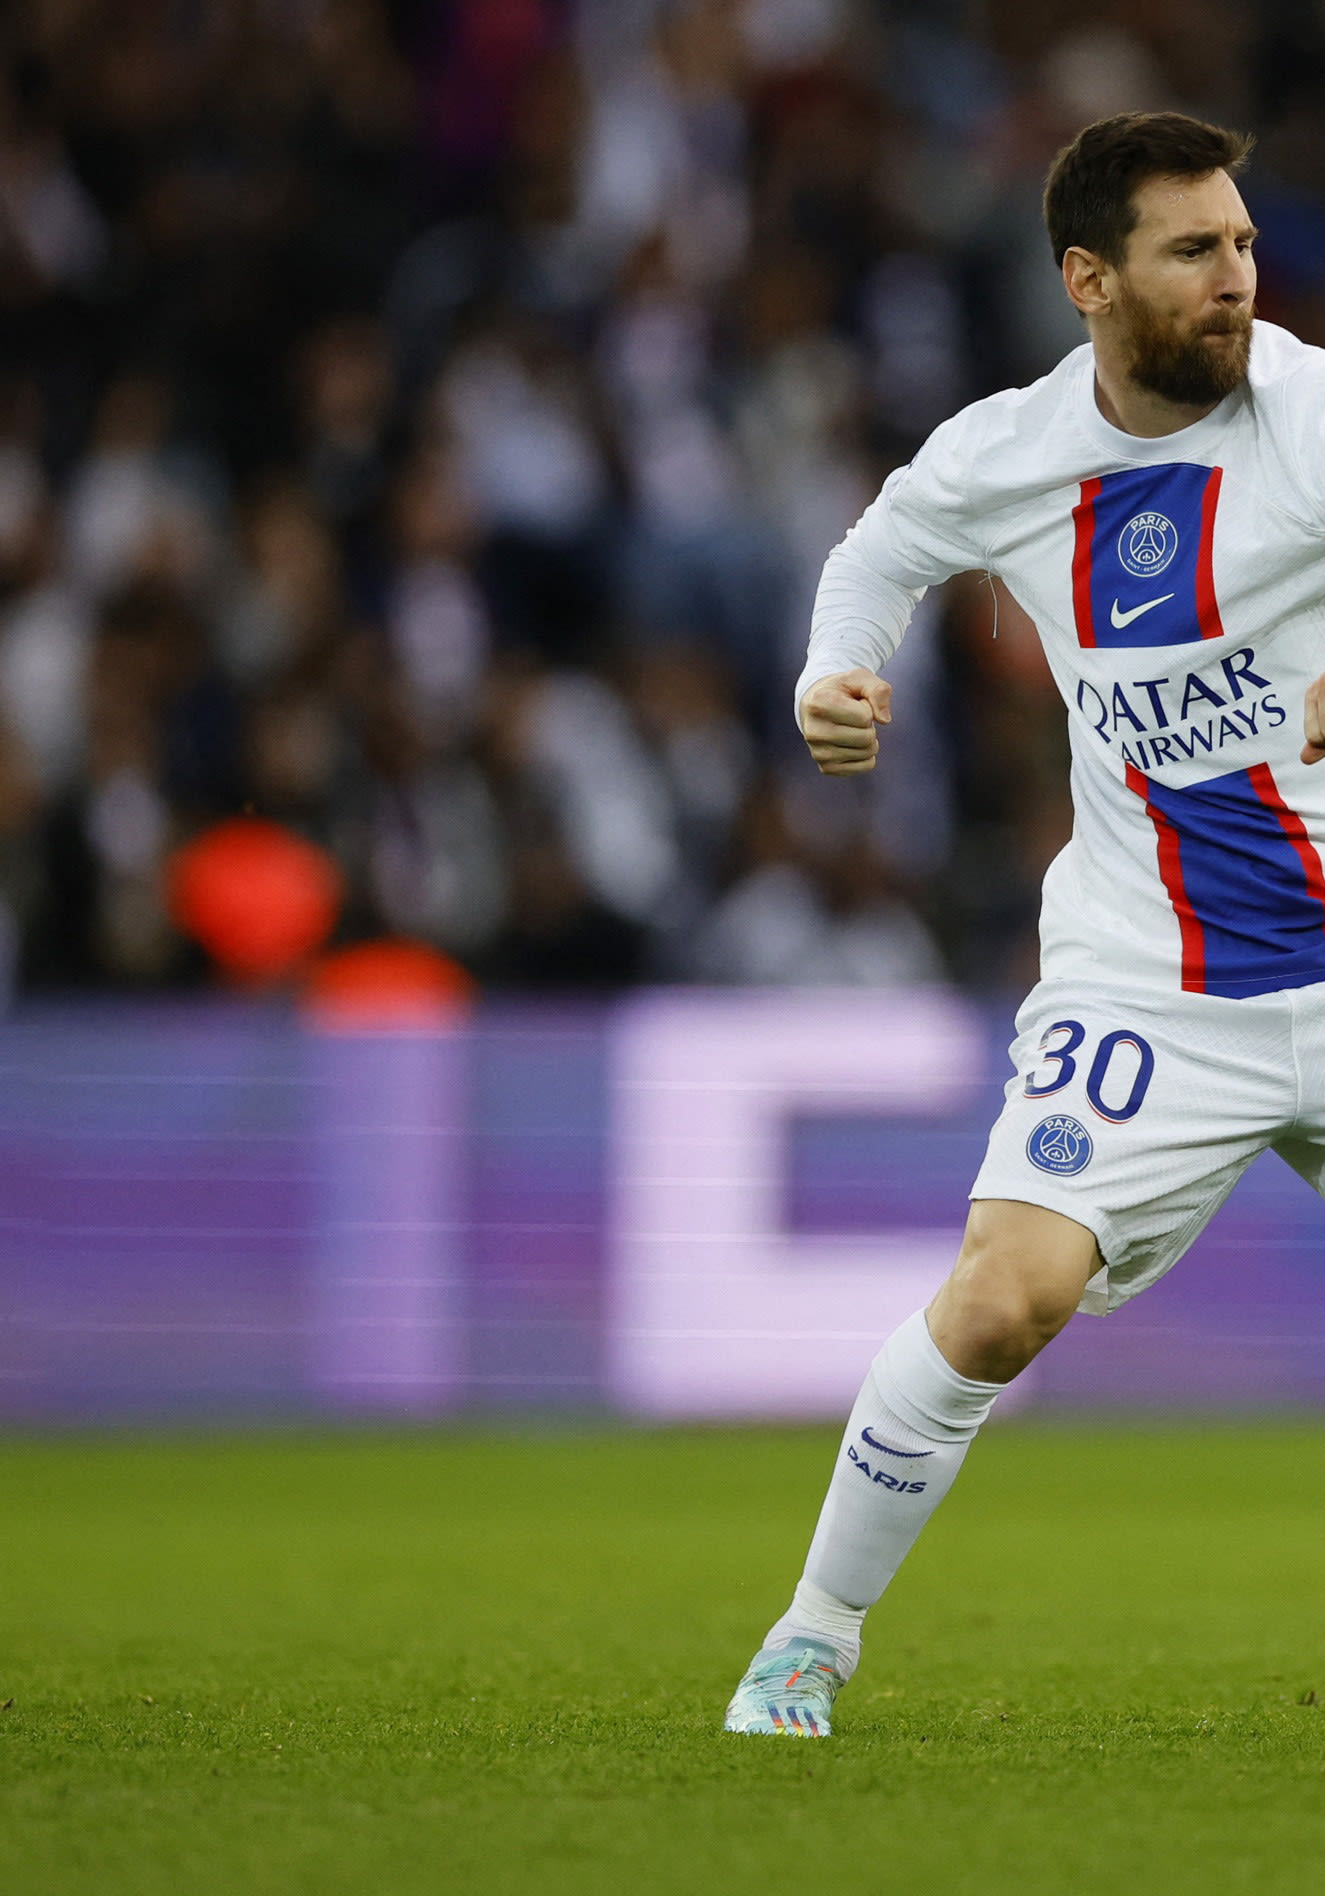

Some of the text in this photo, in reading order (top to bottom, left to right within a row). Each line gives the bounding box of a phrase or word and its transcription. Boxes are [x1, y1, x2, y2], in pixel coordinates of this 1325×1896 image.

[1130, 515, 1169, 532] PARIS
[1077, 647, 1273, 744] QATAR
[1121, 693, 1287, 771] AIRWAYS
[1023, 1019, 1155, 1125] 30
[1044, 1118, 1086, 1141] PARIS
[847, 1444, 928, 1494] PARIS
